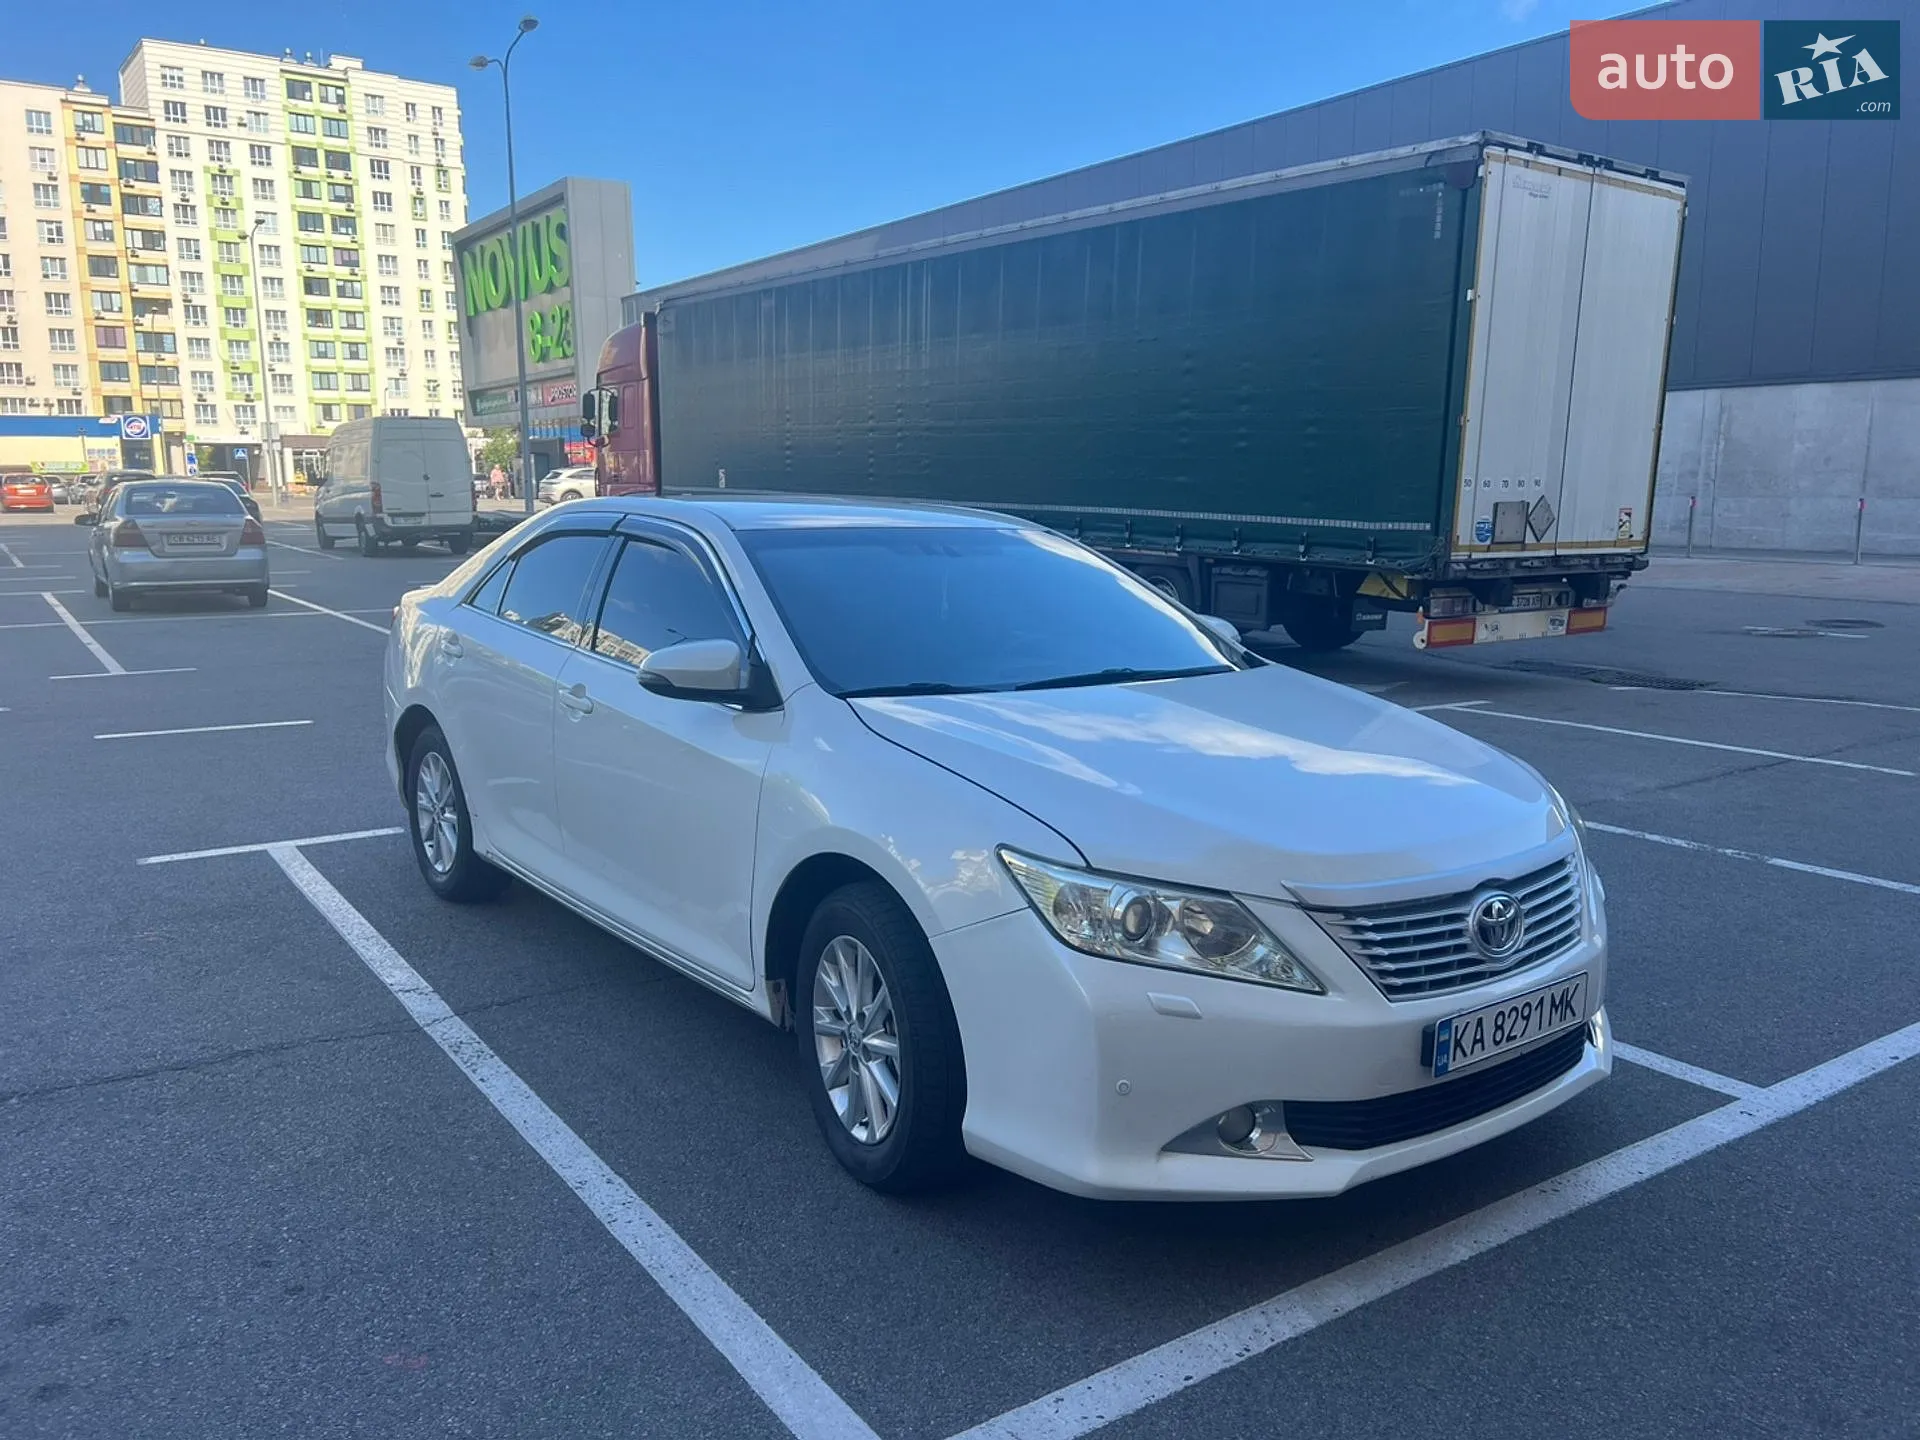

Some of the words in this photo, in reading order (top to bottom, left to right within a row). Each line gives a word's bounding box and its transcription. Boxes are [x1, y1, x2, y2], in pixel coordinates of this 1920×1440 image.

[463, 207, 569, 317] NOVUS
[528, 303, 575, 363] 8-23
[1452, 1016, 1485, 1062] KA
[1492, 993, 1545, 1046] 8291
[1548, 983, 1580, 1027] MK
